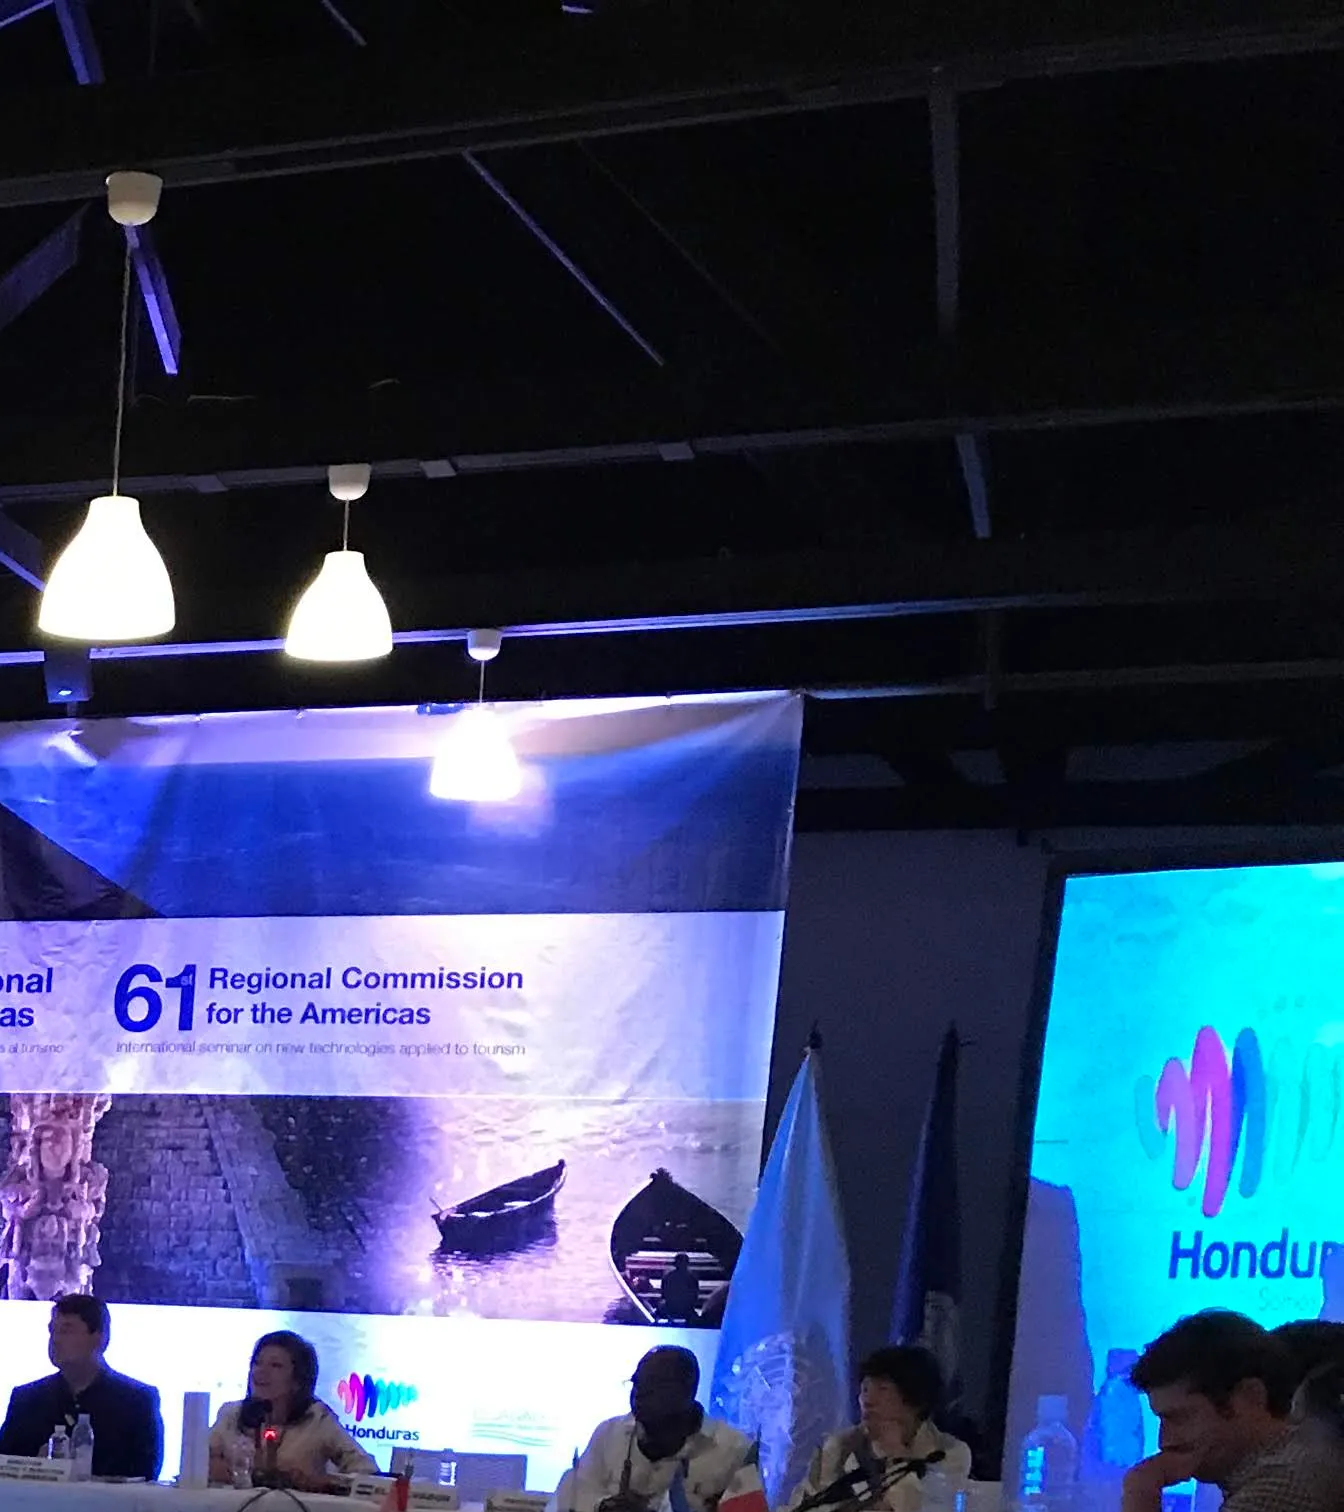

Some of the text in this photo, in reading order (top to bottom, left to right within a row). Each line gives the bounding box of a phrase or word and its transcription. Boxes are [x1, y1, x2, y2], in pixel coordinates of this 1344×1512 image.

[209, 966, 524, 995] Regional Commission
[113, 964, 198, 1033] 61
[205, 1001, 431, 1026] for the Americas
[116, 1040, 196, 1053] International
[199, 1041, 252, 1053] seminar
[255, 1043, 272, 1053] on
[399, 1043, 451, 1057] applied
[455, 1043, 469, 1055] to
[1168, 1227, 1344, 1279] Hondur
[344, 1424, 420, 1441] Honduras
